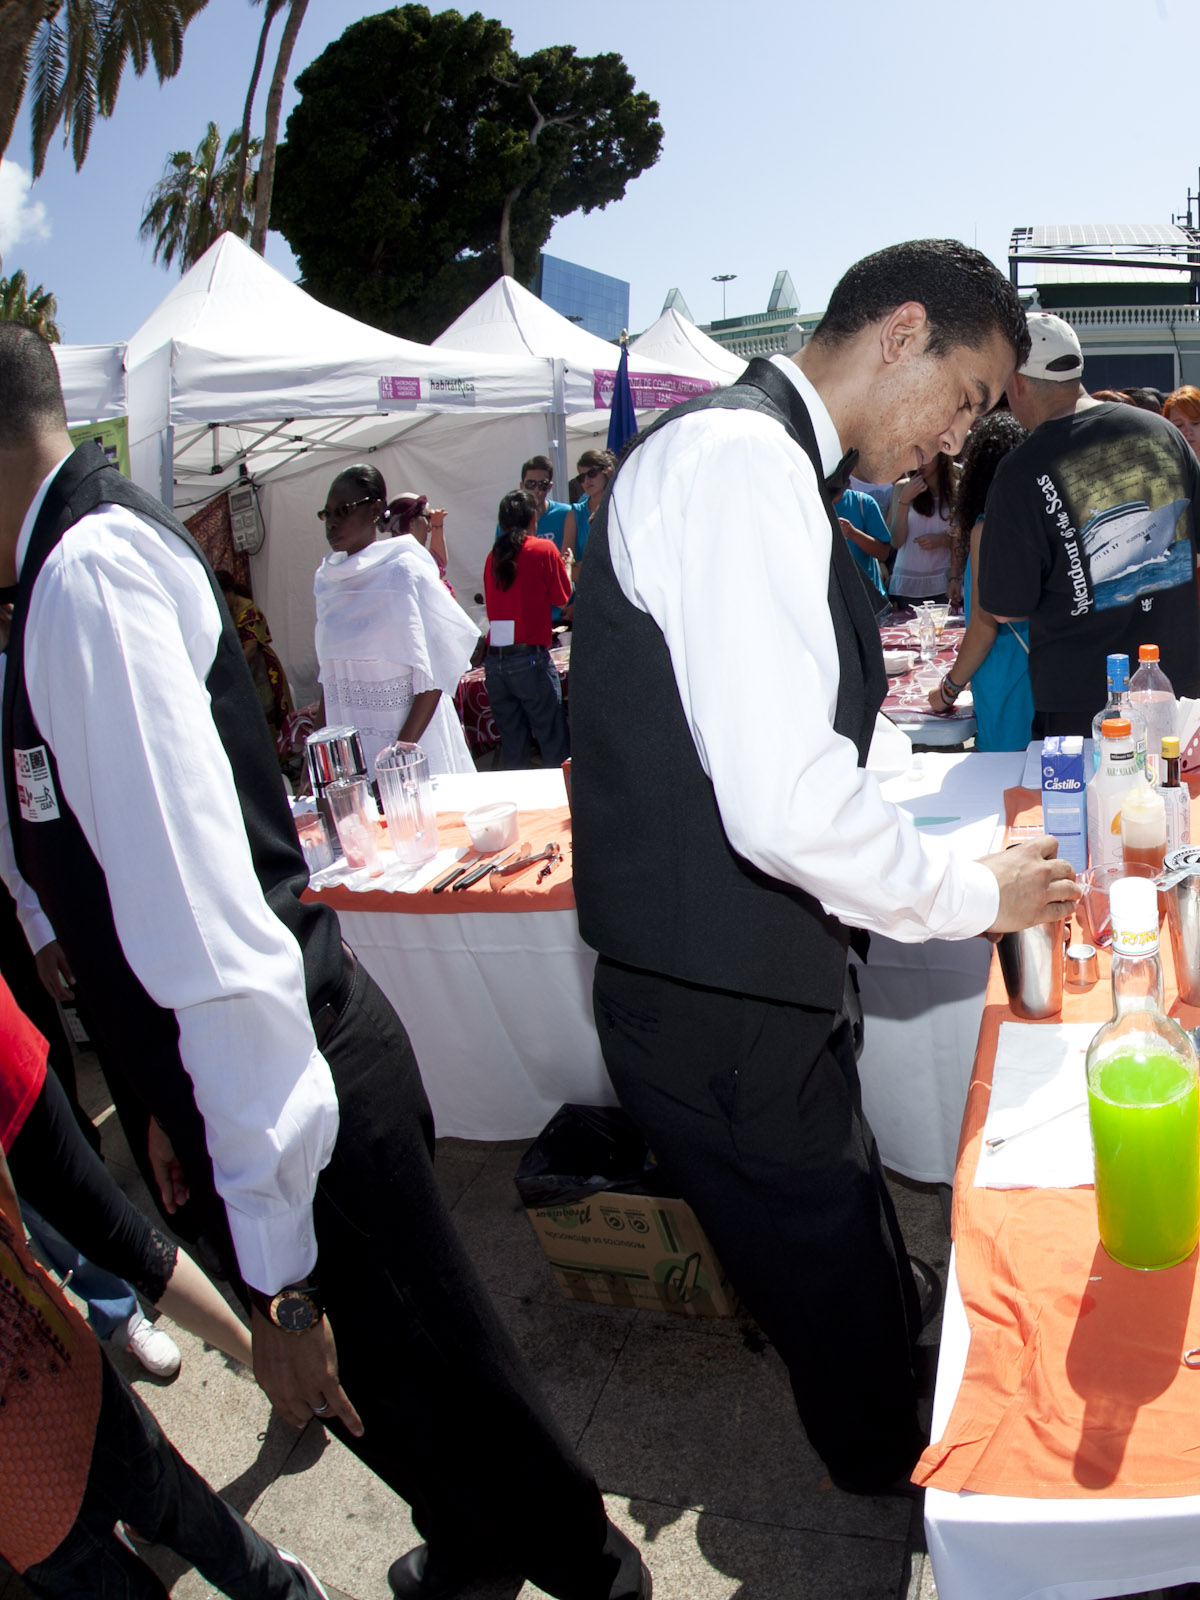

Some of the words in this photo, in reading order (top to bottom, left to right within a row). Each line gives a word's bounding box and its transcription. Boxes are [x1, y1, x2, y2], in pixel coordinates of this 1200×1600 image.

[1036, 474, 1063, 515] Seas
[1056, 511, 1071, 528] the
[1060, 526, 1077, 539] of
[1063, 540, 1094, 617] Splendour
[1044, 779, 1081, 790] Castillo
